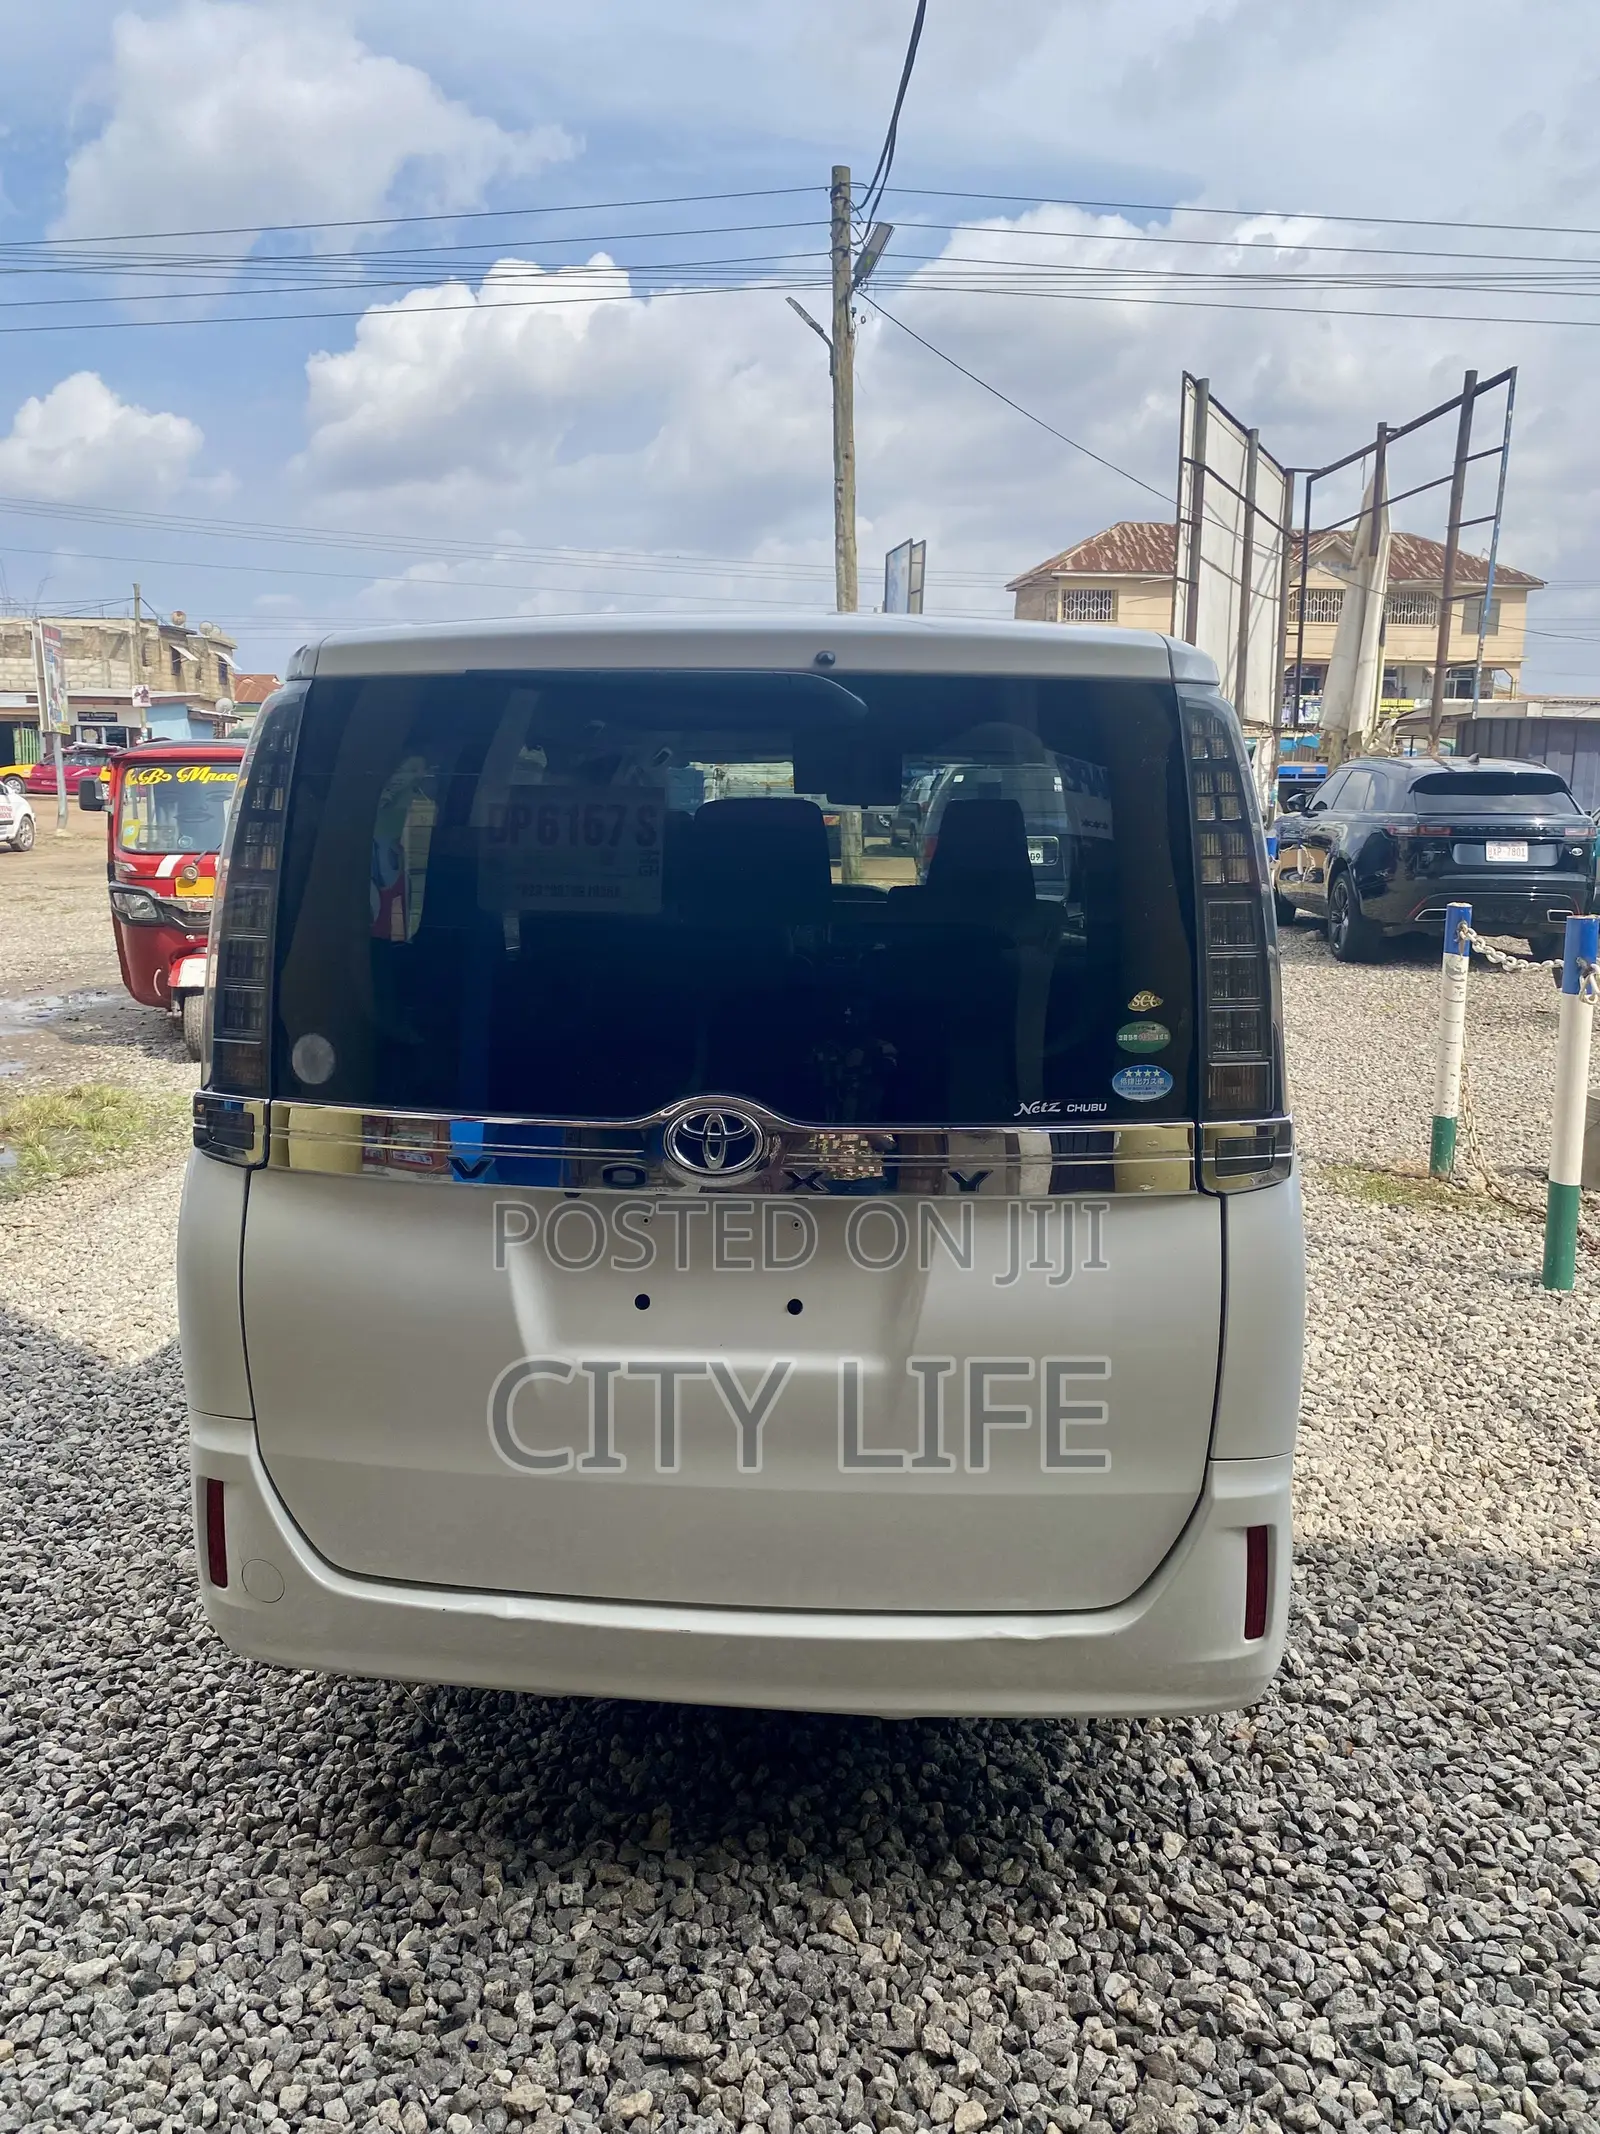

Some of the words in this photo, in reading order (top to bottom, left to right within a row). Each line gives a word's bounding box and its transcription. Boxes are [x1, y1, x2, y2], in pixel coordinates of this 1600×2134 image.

[1013, 1101, 1062, 1117] Netz
[1066, 1103, 1108, 1113] CHUBU
[446, 1155, 995, 1192] VOXY
